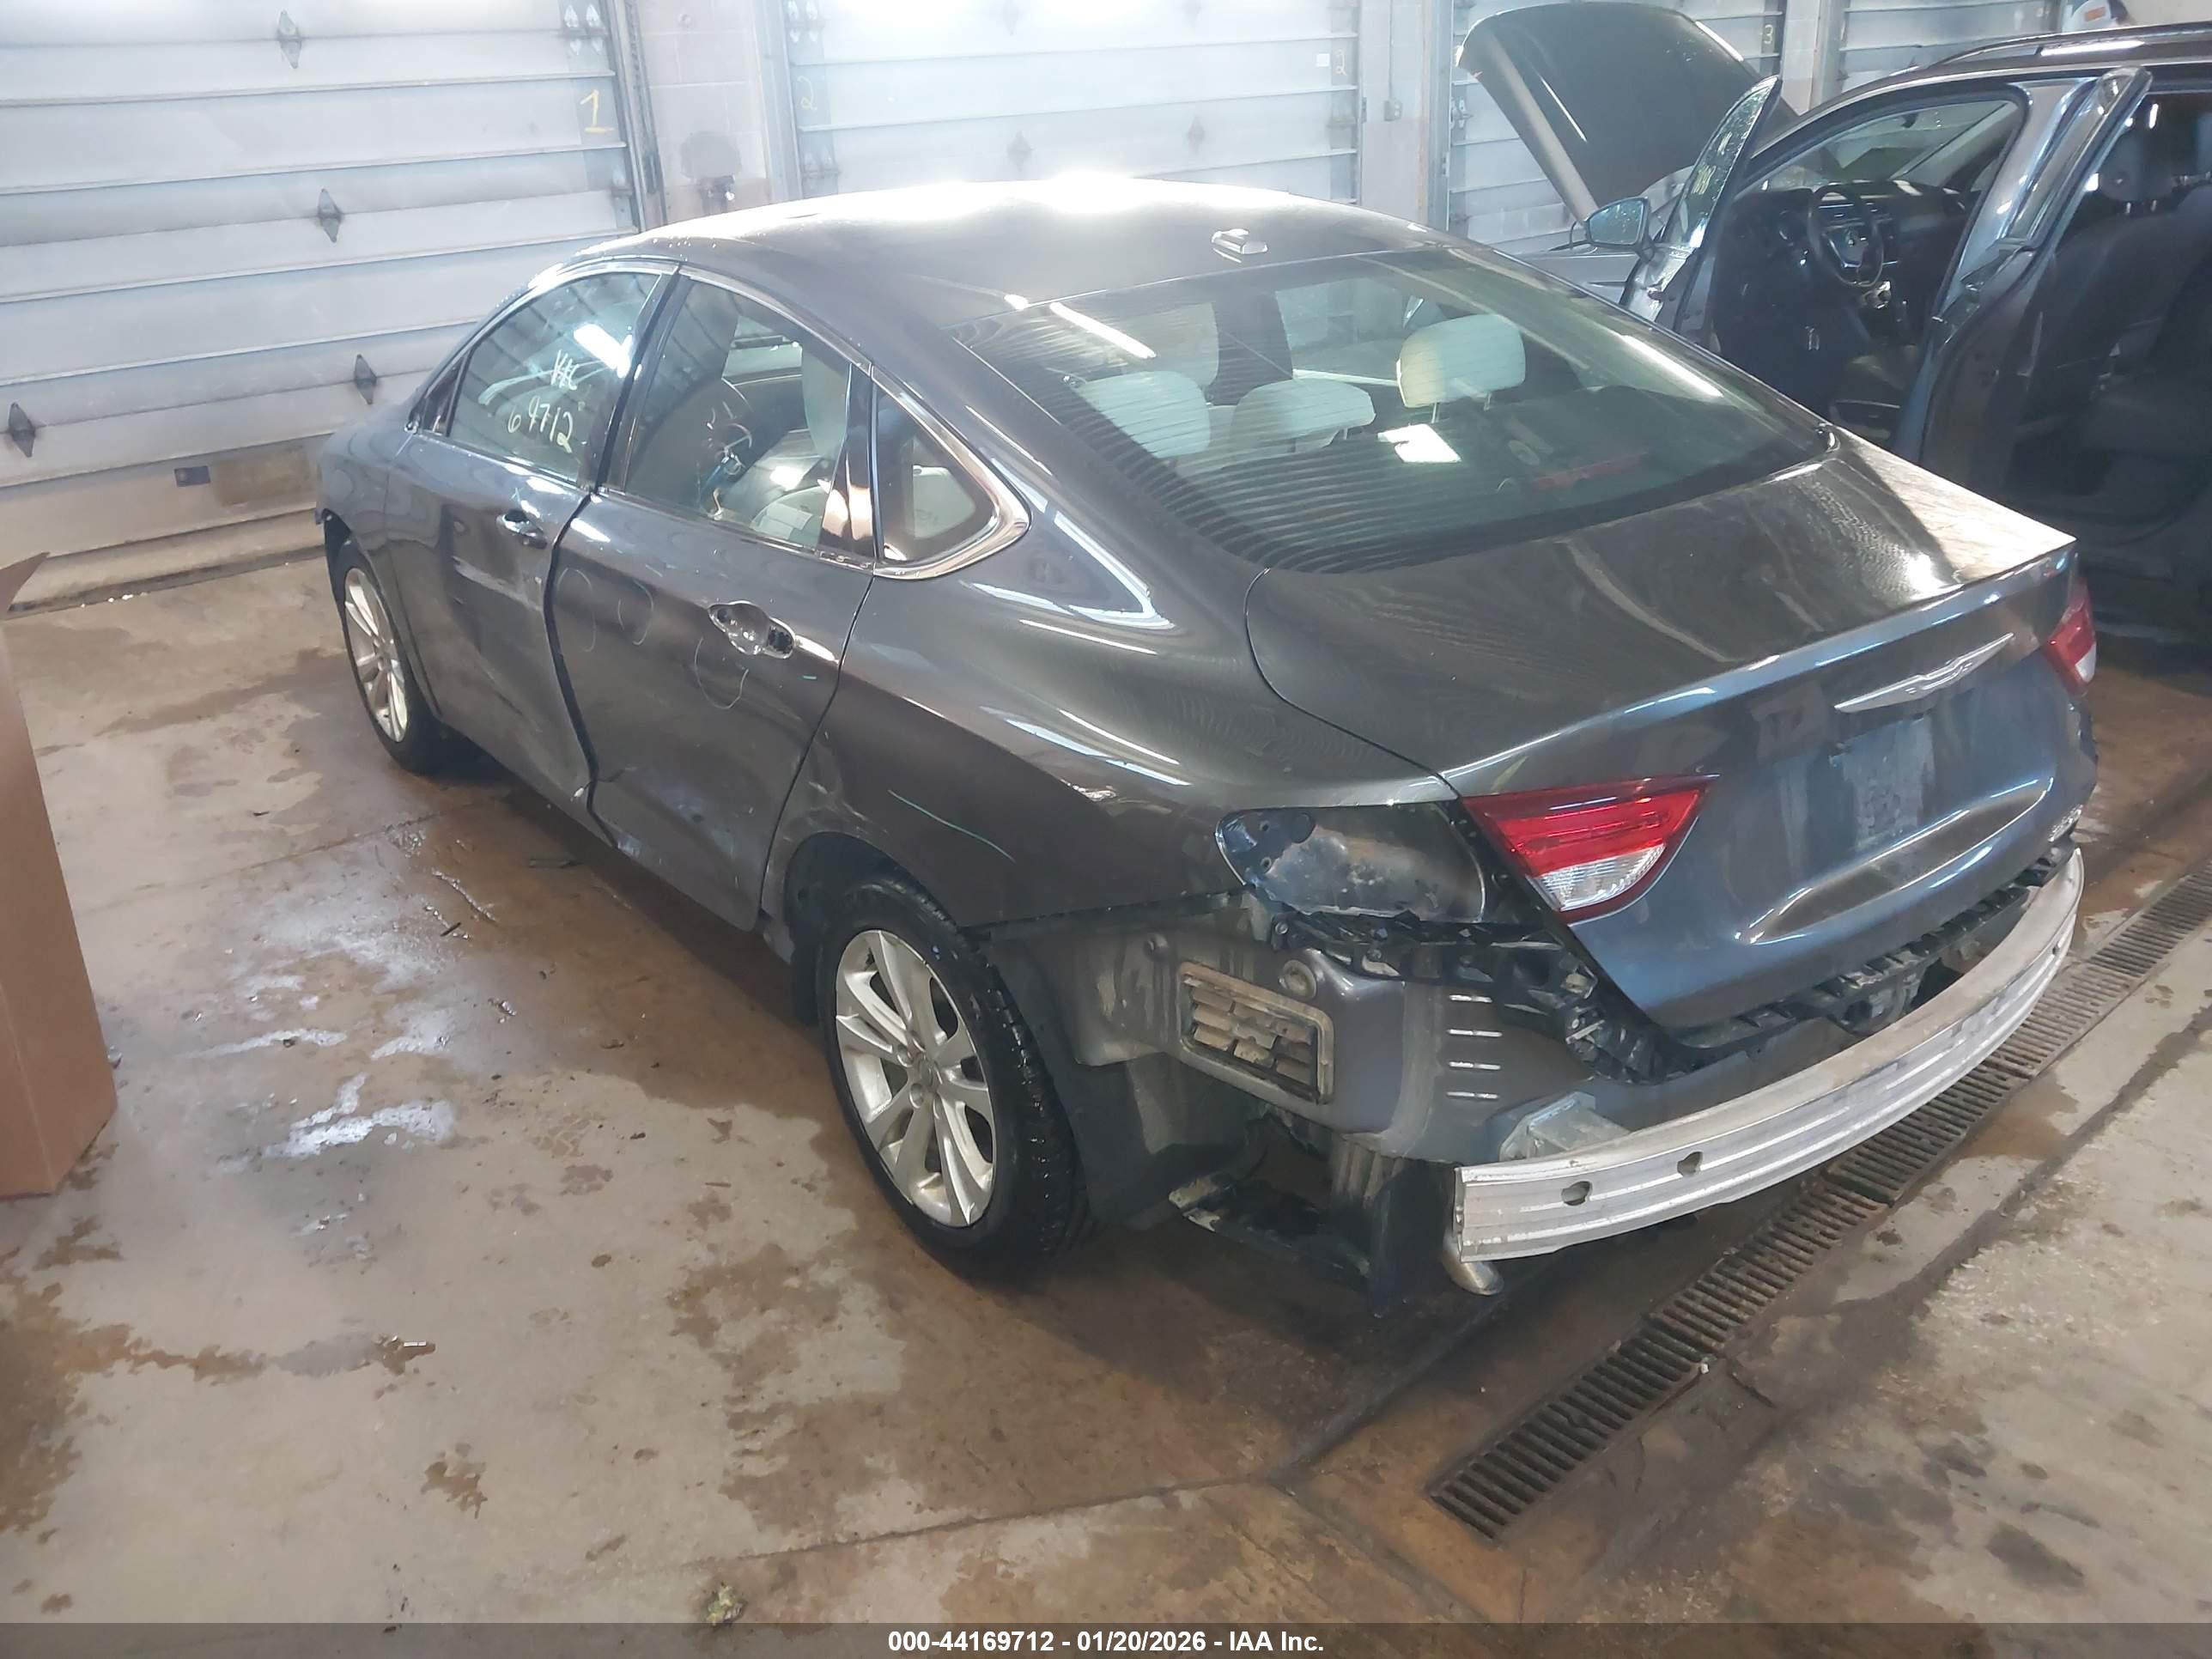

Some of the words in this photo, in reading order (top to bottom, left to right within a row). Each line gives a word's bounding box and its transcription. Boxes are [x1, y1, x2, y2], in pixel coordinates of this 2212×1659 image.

[1763, 23, 1774, 45] 3
[580, 88, 616, 133] 1
[796, 75, 818, 111] 2
